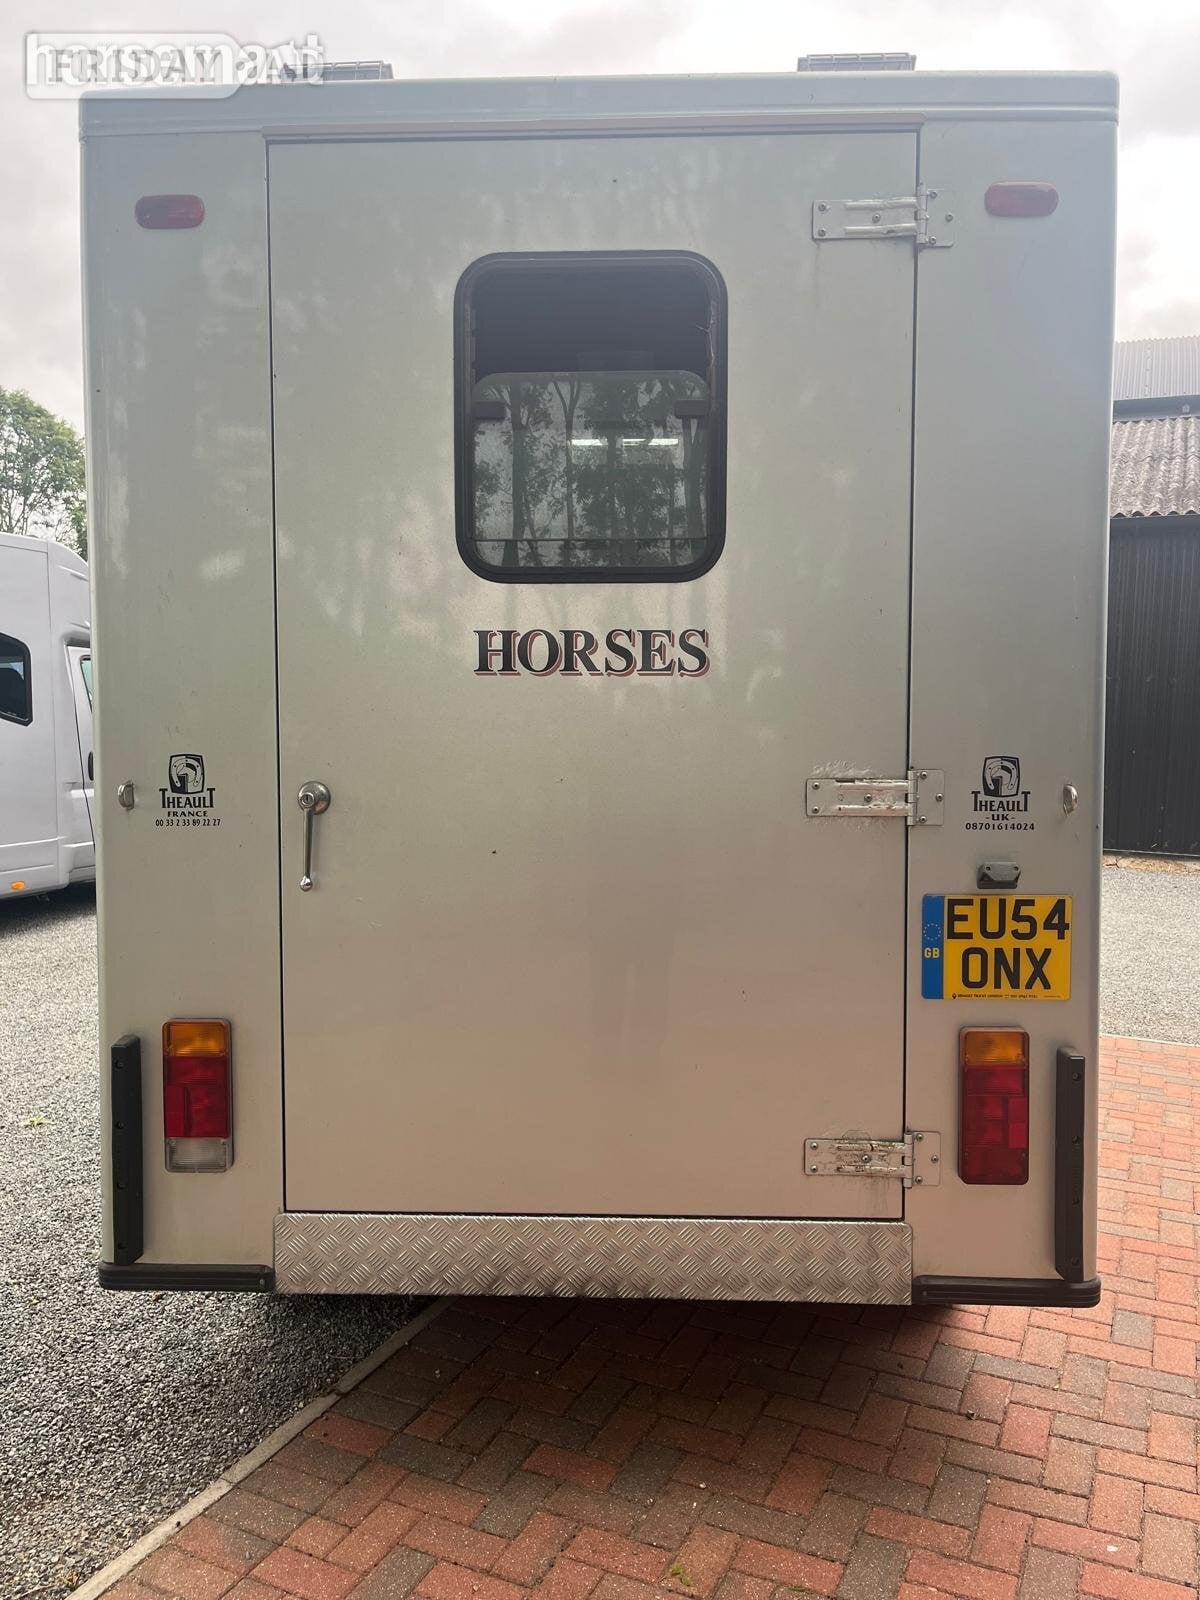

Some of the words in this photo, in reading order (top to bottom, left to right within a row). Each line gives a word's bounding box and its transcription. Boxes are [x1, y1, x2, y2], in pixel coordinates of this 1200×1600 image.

[473, 628, 711, 677] HORSES
[159, 787, 216, 808] THEAULT
[971, 791, 1031, 812] THEAULT
[155, 818, 164, 827] 00
[166, 818, 174, 827] 33
[176, 818, 180, 827] 2
[182, 818, 190, 827] 33
[965, 822, 1035, 830] 08701614024
[947, 898, 1070, 940] EU54
[923, 947, 940, 959] GB
[961, 947, 1052, 990] ONX
